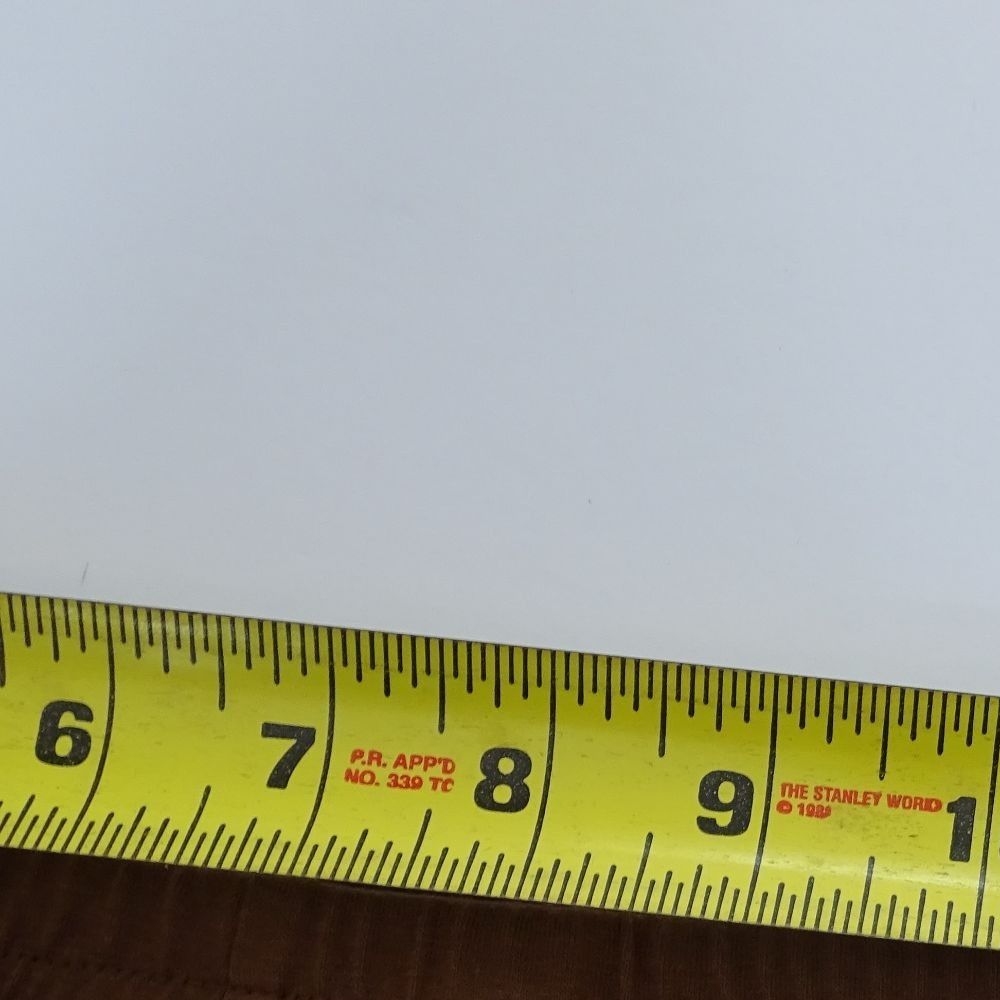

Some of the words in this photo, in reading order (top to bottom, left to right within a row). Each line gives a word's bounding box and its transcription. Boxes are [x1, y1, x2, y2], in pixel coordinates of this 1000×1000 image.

[34, 700, 95, 767] 6
[261, 722, 317, 789] 7
[350, 748, 387, 768] P.R.
[393, 753, 456, 774] APP'D
[344, 768, 380, 786] NO.
[386, 773, 423, 790] 339
[429, 776, 454, 793] TC
[474, 747, 533, 813] 8
[696, 770, 755, 836] 9
[780, 782, 809, 799] THE
[813, 785, 883, 806] STANLEY
